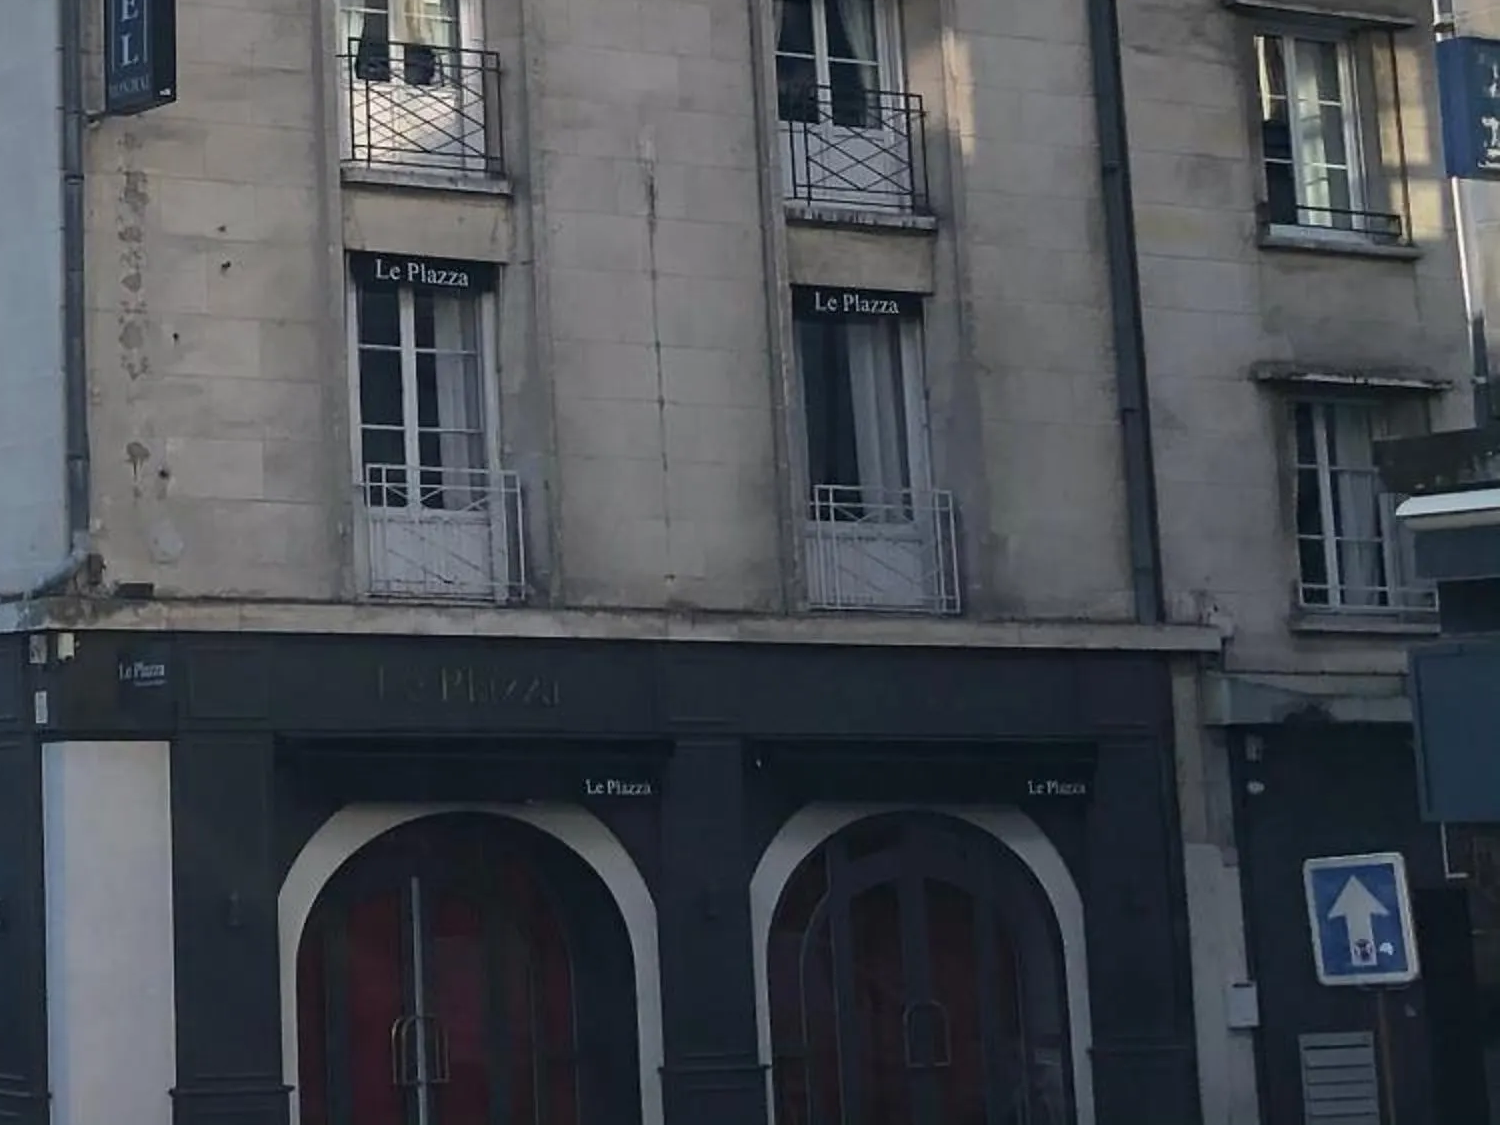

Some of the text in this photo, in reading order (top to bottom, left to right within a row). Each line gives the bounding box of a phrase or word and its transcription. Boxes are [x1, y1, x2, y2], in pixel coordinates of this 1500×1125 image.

[375, 258, 469, 286] Le Plazza
[815, 291, 900, 314] Le Plazza
[119, 662, 132, 680] Le
[586, 778, 652, 796] Le Plazza
